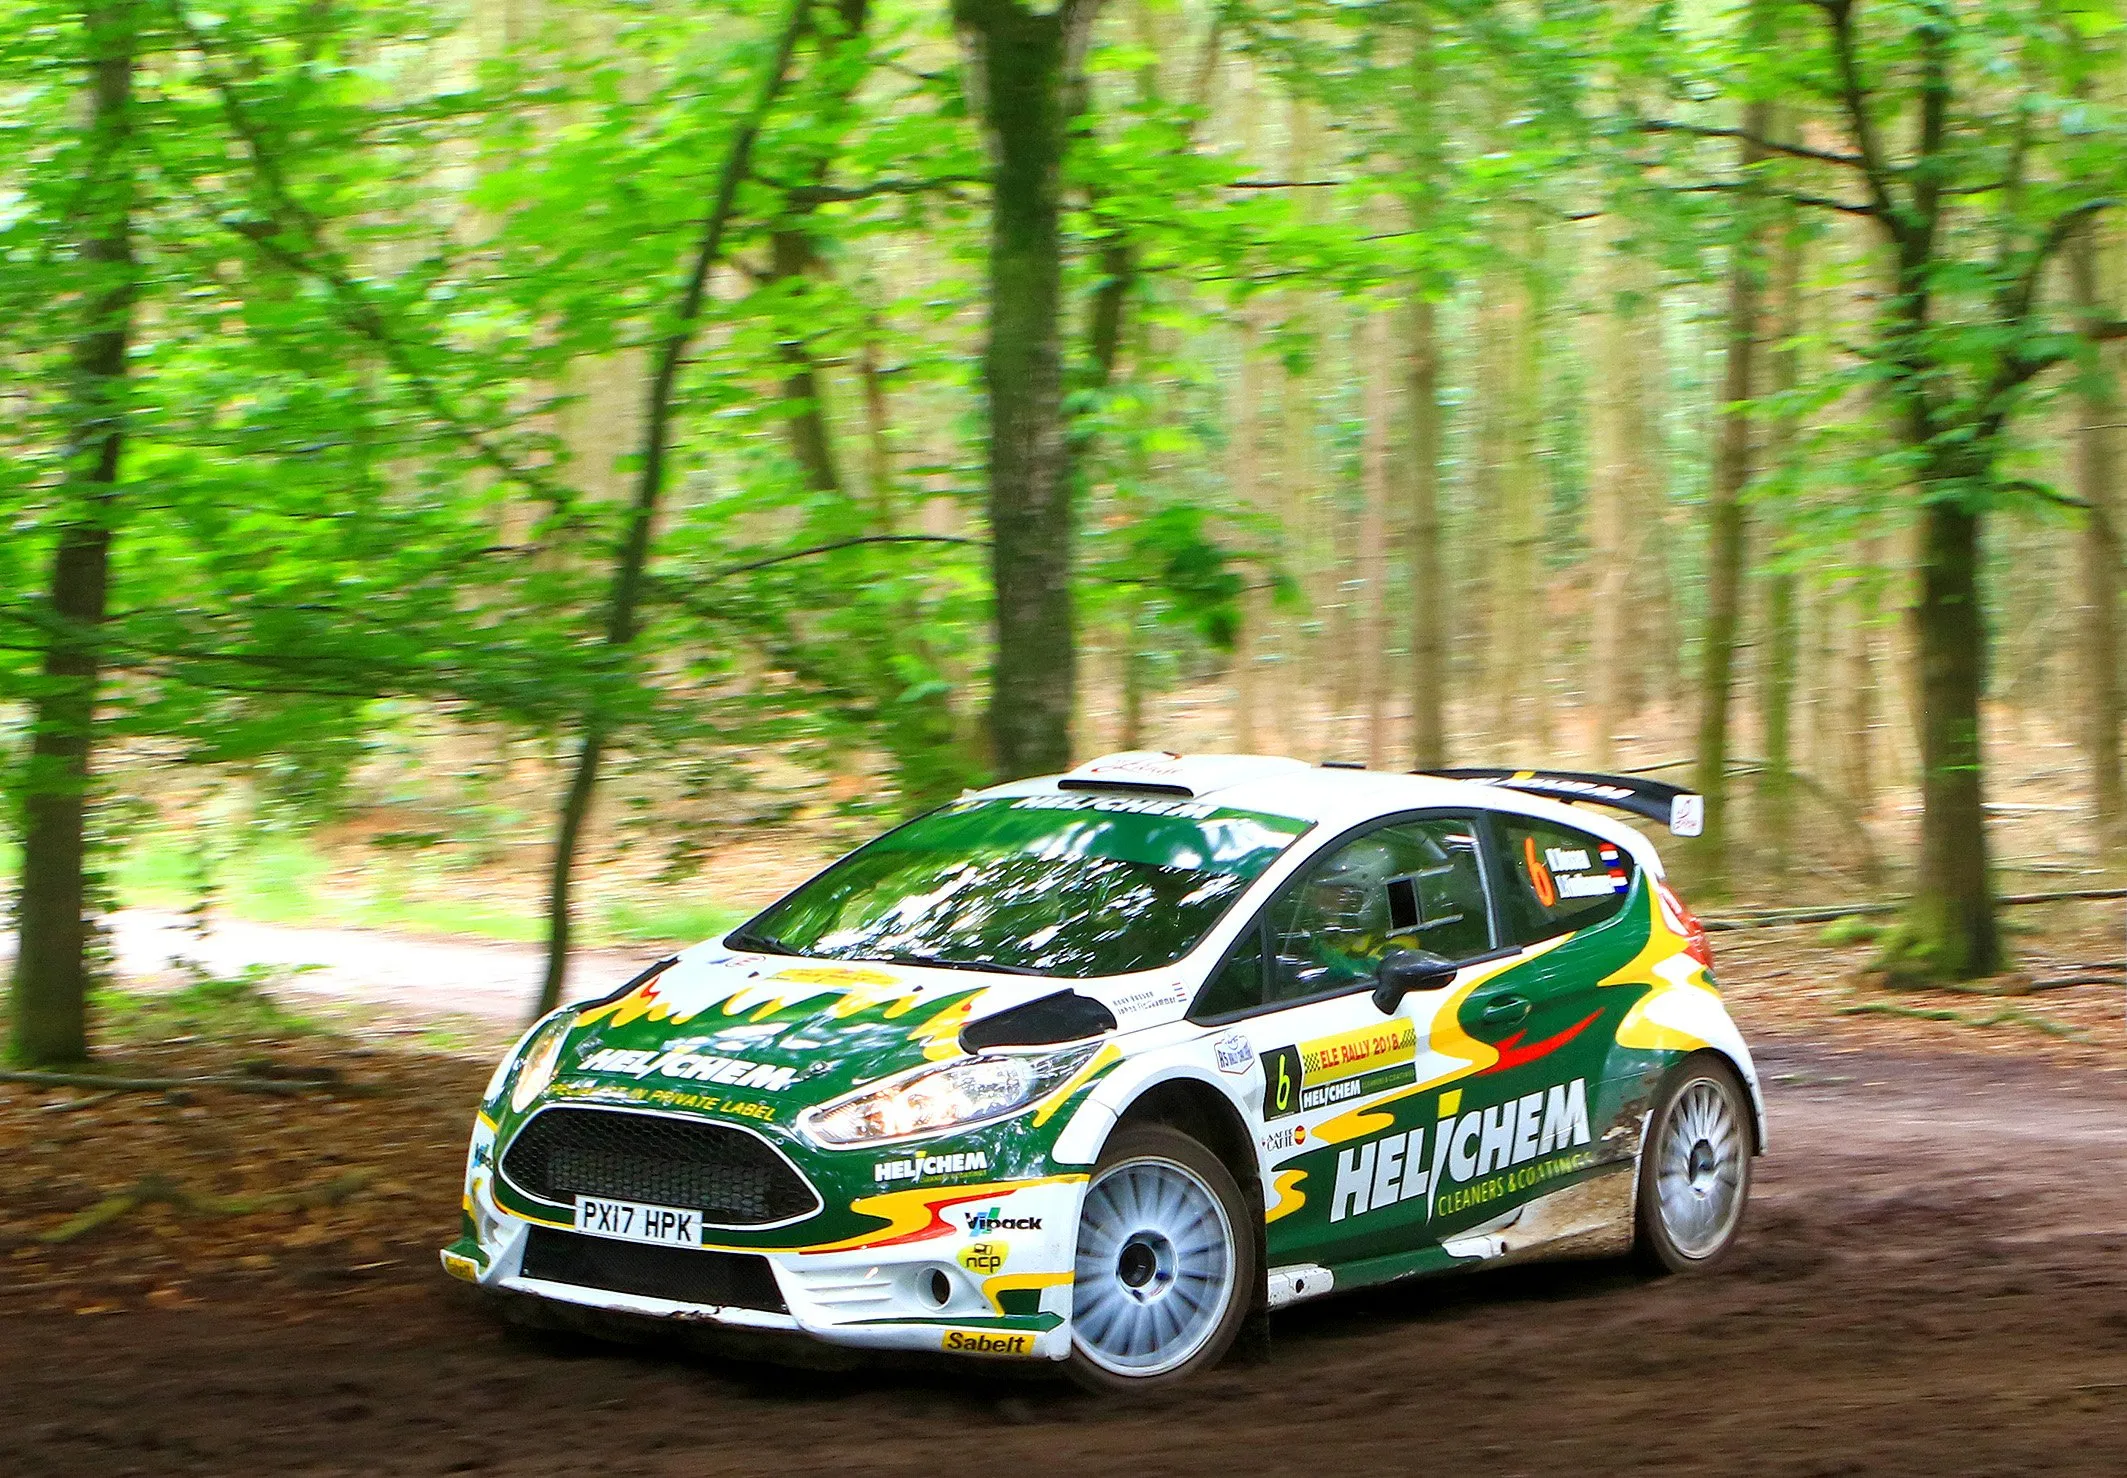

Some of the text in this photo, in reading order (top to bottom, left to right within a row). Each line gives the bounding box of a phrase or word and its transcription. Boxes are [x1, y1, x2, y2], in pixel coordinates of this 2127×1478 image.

[1524, 836, 1555, 907] 6
[1319, 1033, 1400, 1069] ELE RALLY 2018
[1276, 1054, 1291, 1111] 6
[650, 1089, 721, 1111] PRIVATE
[721, 1099, 776, 1121] LABEL
[1437, 1177, 1504, 1217] CLEANERS
[583, 1200, 692, 1242] PX17 HPK
[947, 1331, 1025, 1354] Sabelt
